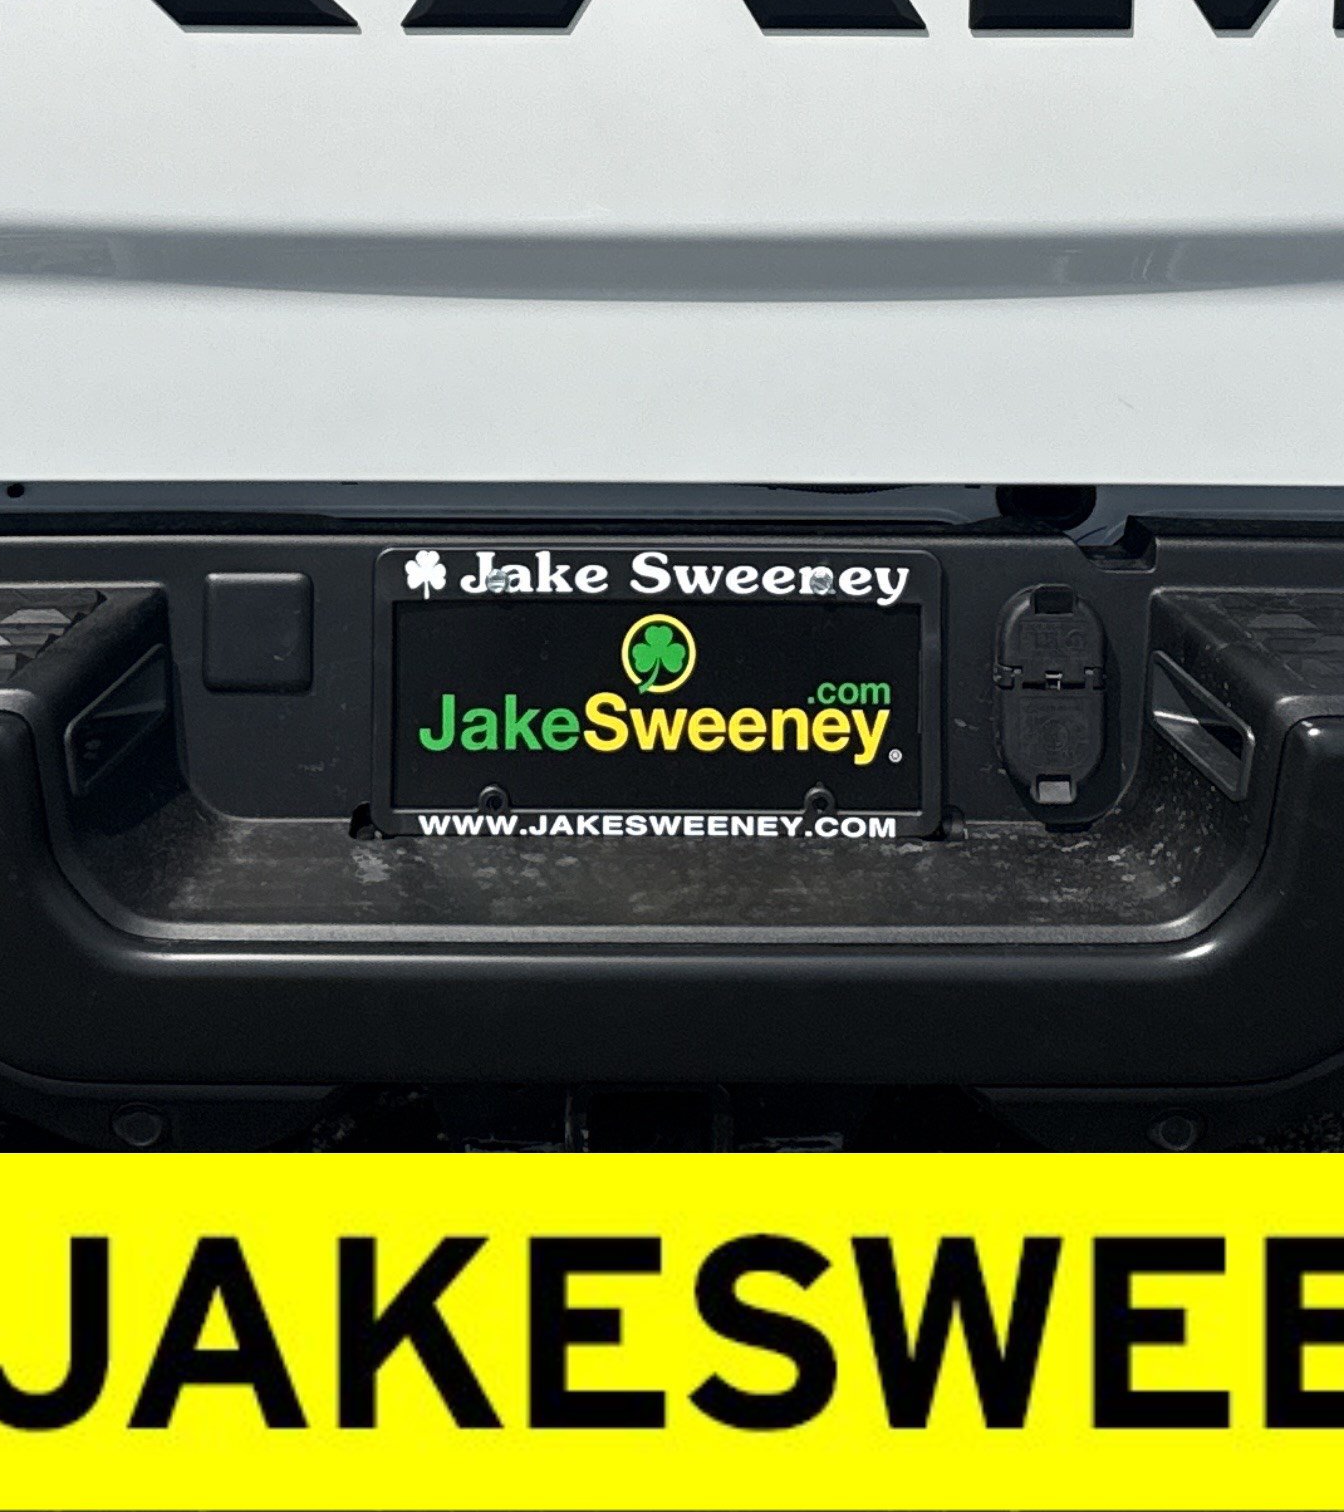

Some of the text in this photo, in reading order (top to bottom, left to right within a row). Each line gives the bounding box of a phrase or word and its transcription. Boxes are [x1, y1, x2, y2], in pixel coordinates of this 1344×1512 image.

[460, 550, 910, 606] Jake Sweeney
[418, 814, 897, 839] WWW.JAKESWEENEY.COM
